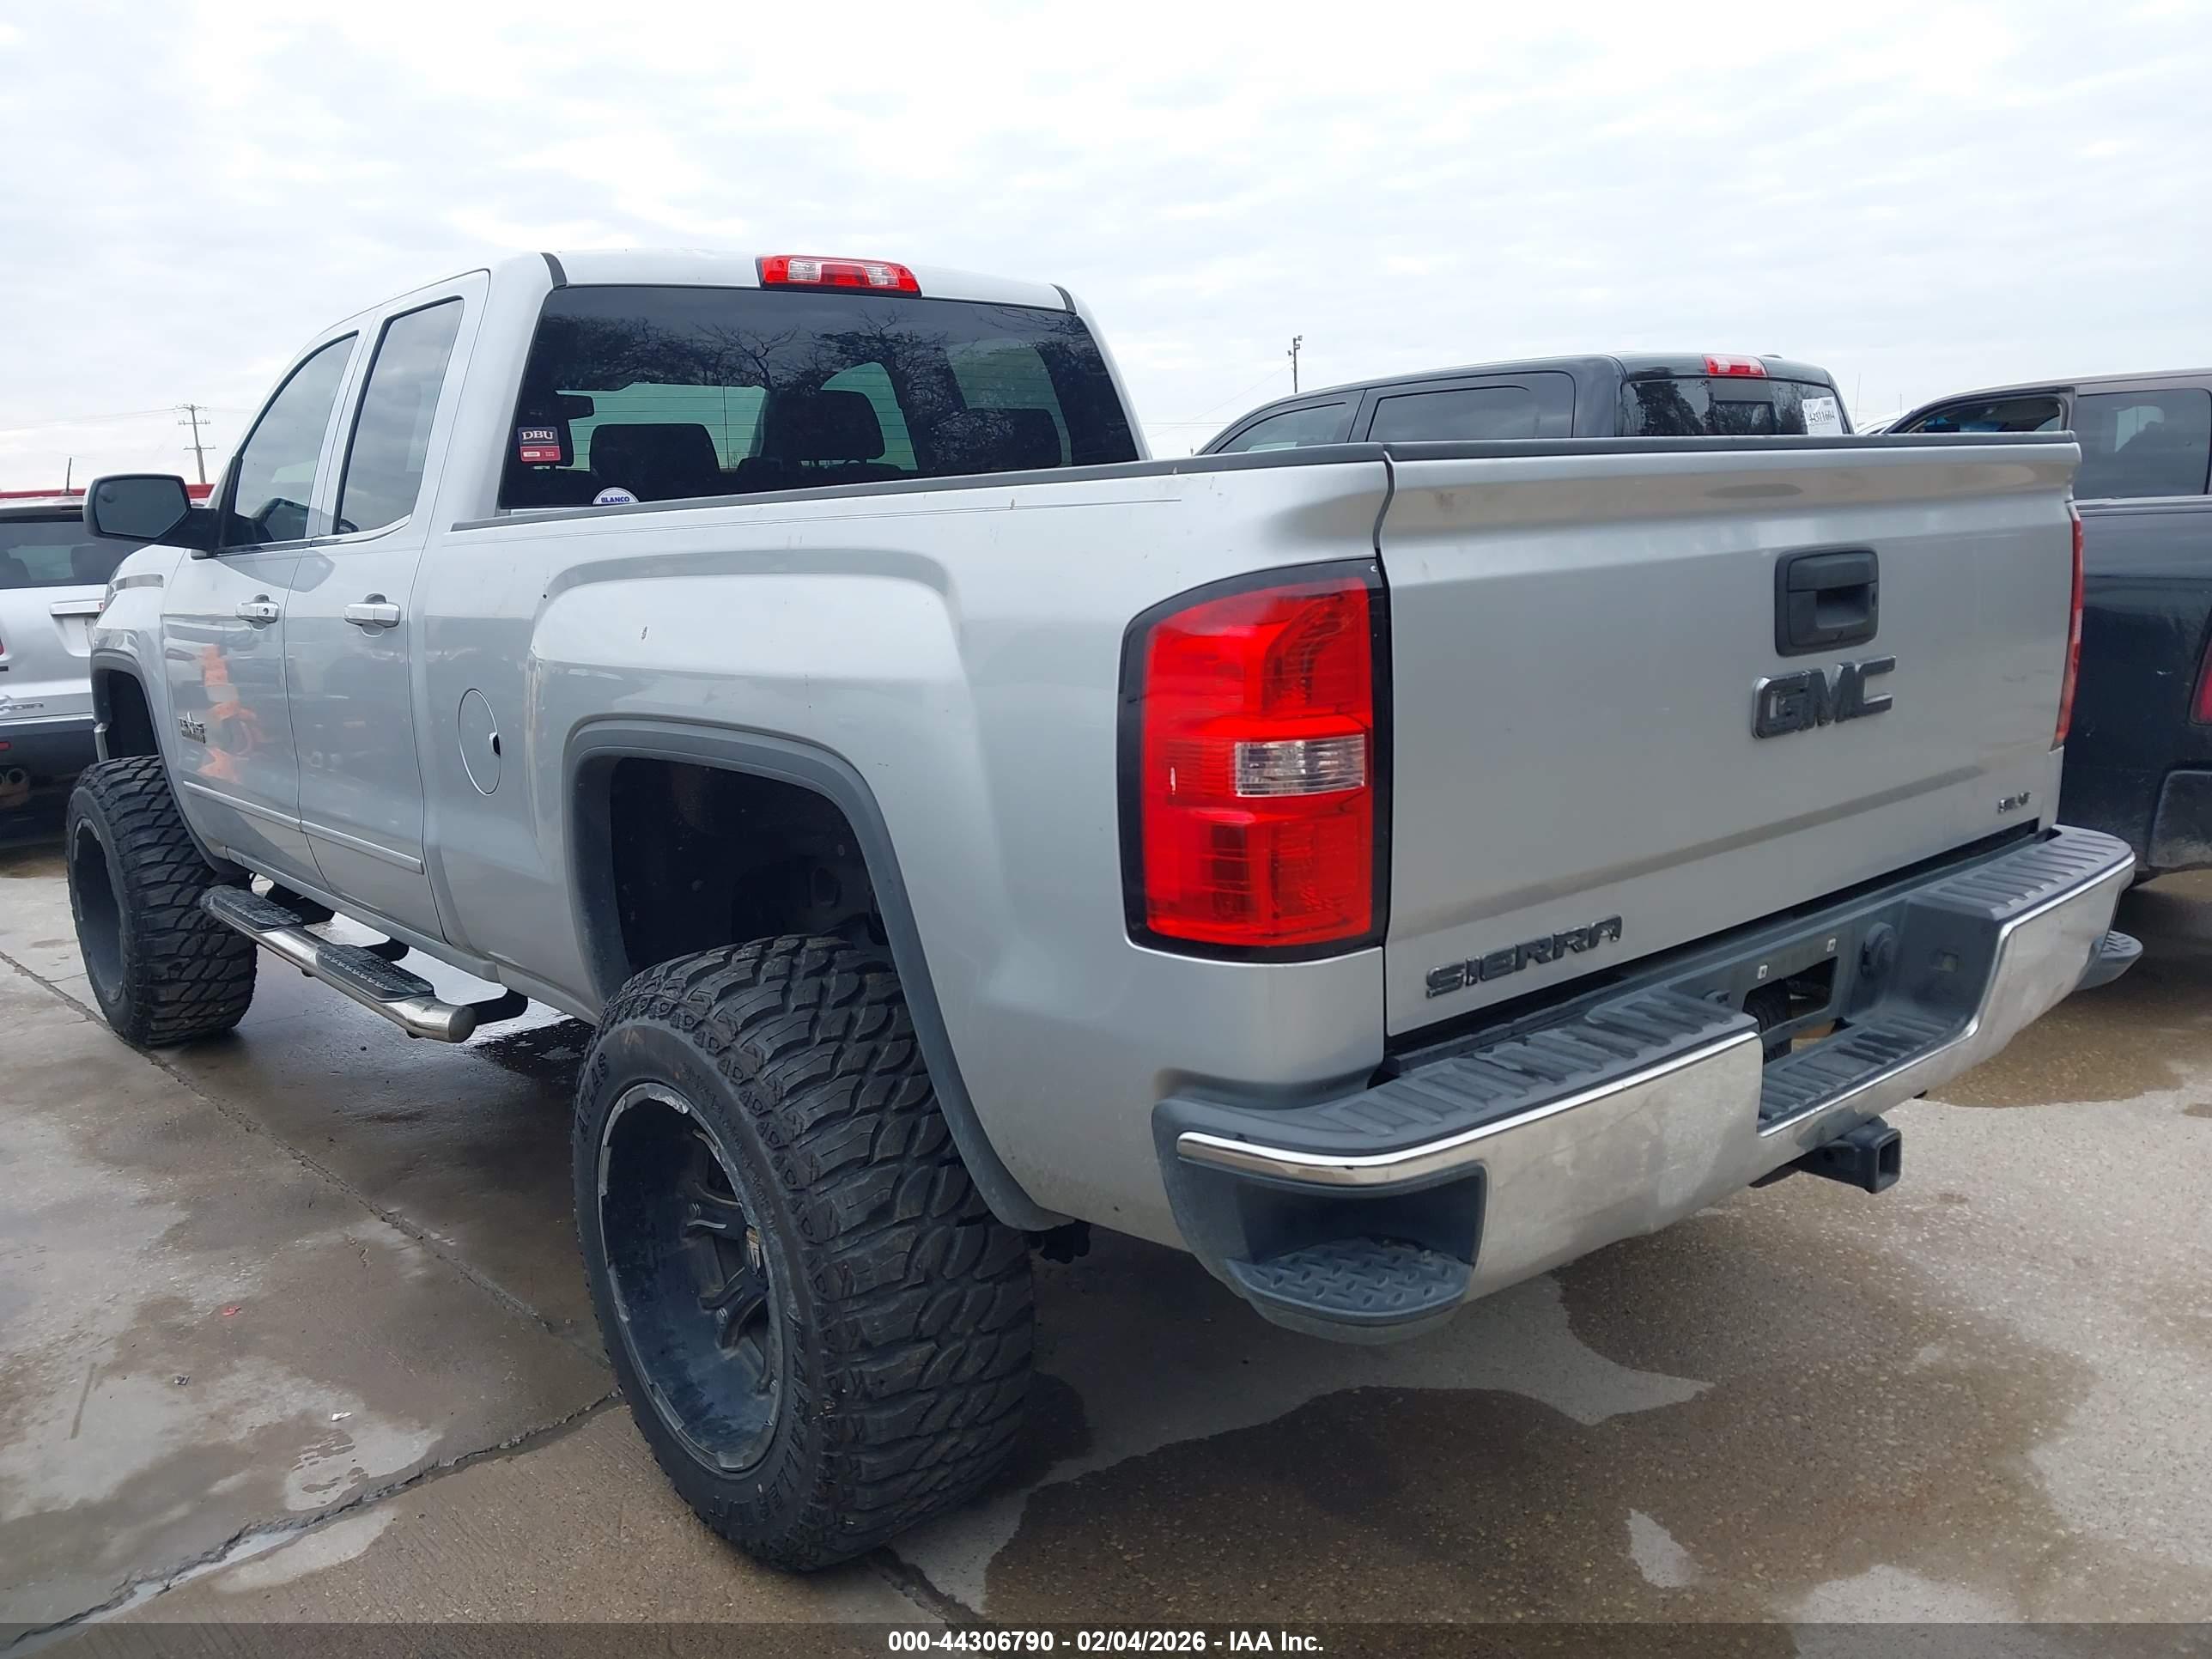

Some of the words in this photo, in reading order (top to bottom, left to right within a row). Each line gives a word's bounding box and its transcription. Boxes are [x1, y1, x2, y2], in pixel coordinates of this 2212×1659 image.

[522, 430, 554, 441] DBU
[1752, 655, 1897, 740] GMC
[1425, 913, 1623, 999] SIERRA
